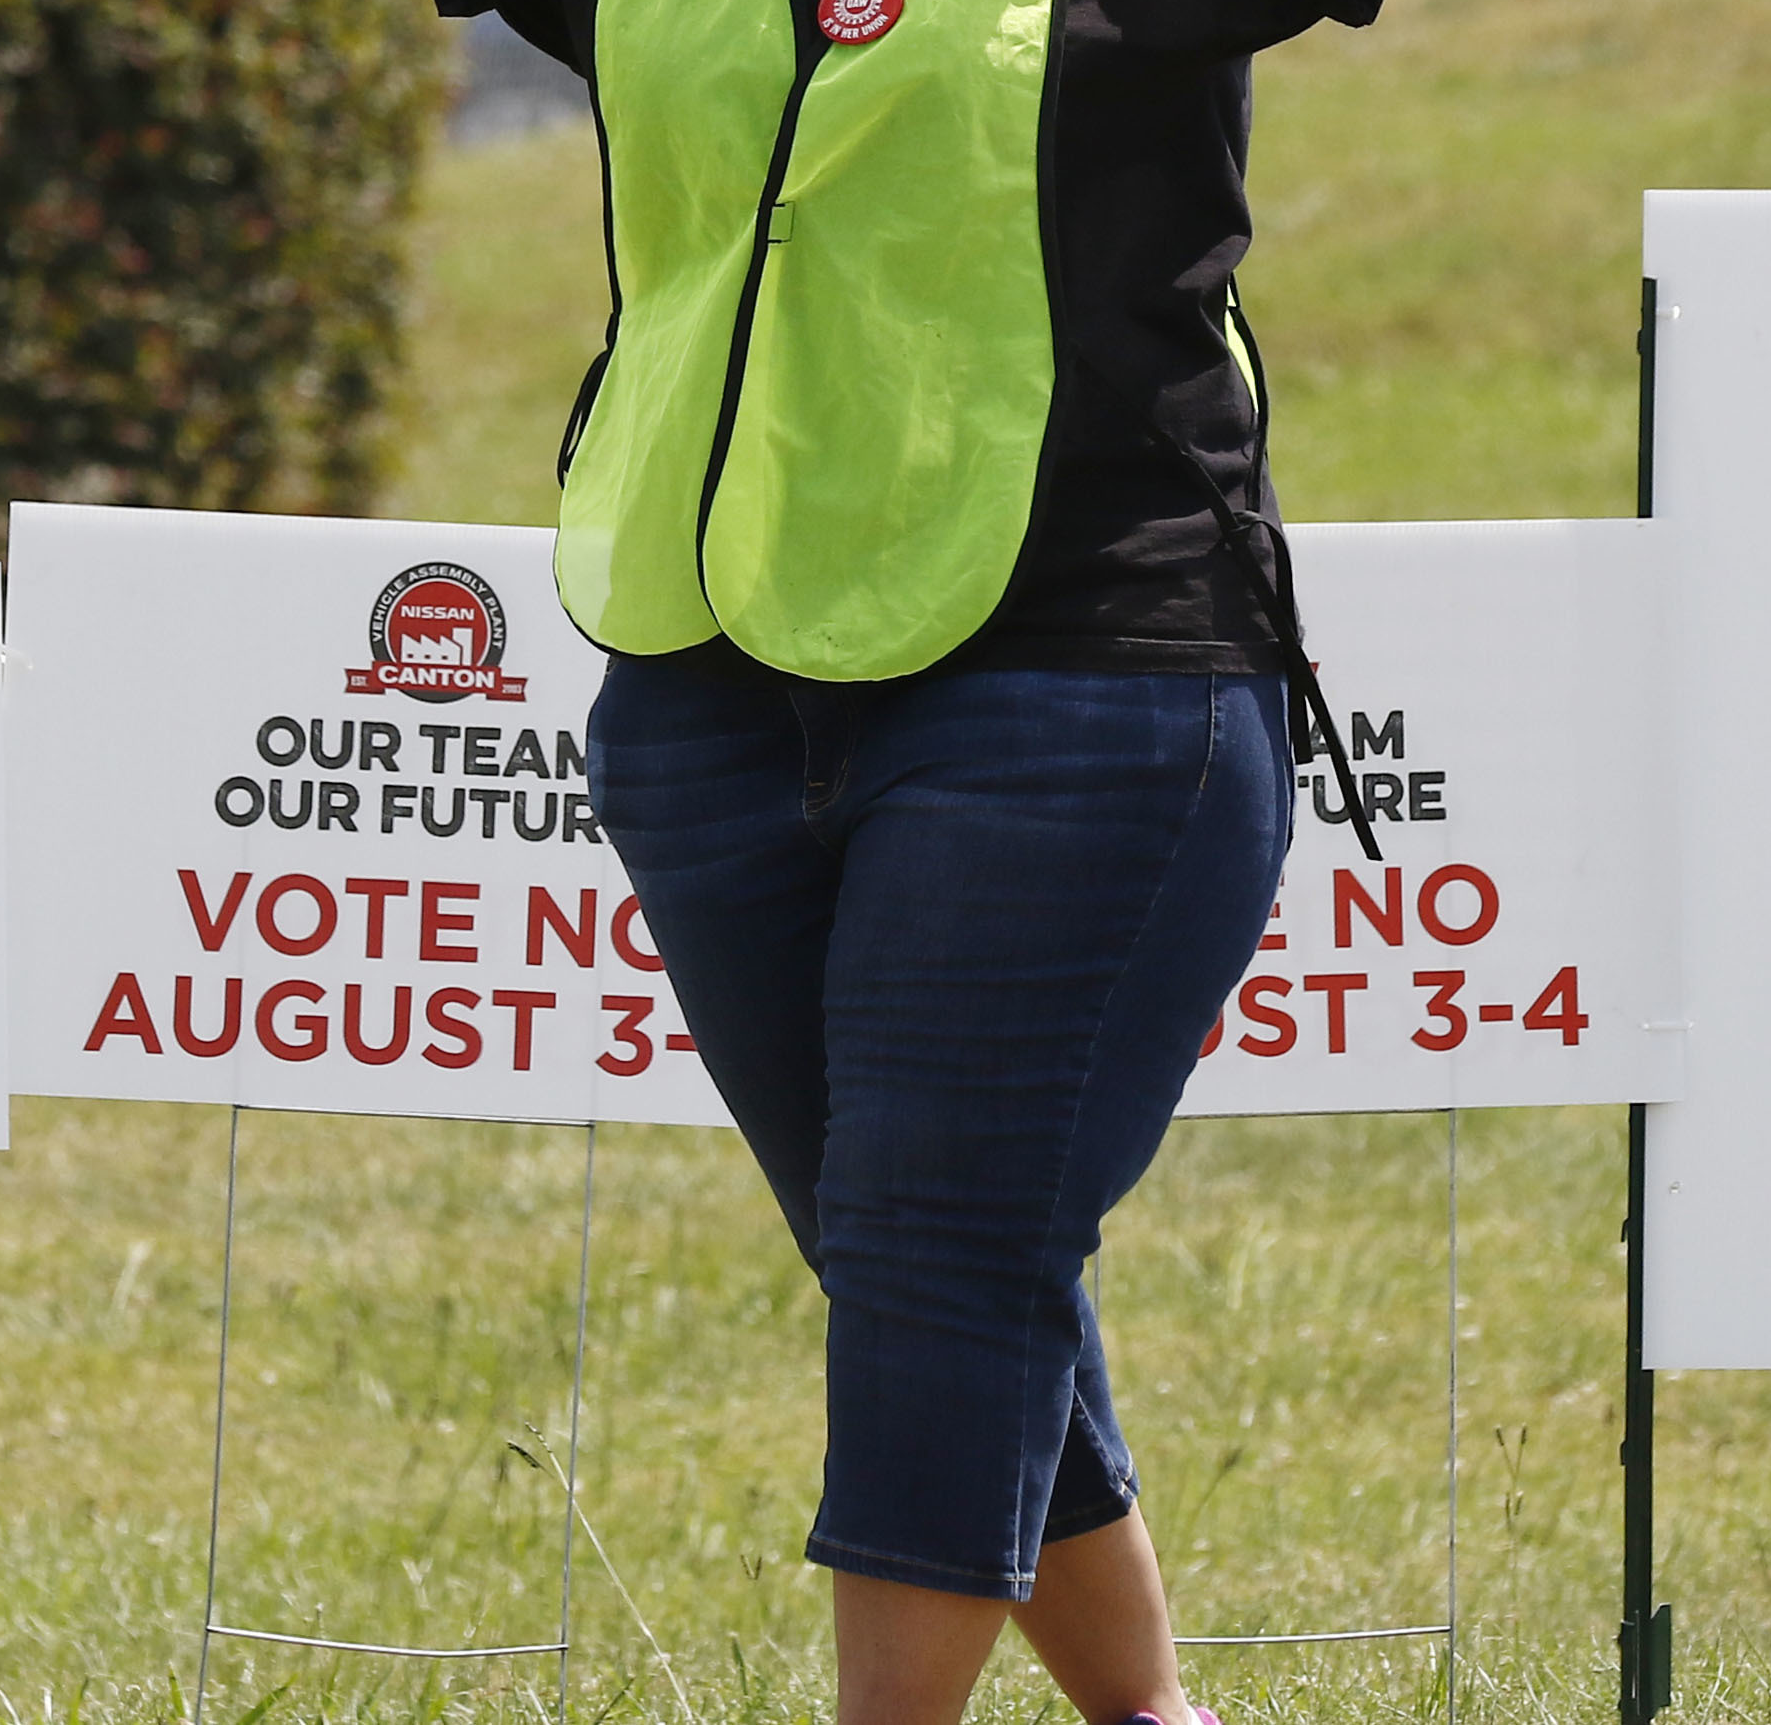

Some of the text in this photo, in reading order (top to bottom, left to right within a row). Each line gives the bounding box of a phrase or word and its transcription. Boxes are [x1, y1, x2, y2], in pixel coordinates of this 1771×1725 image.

[822, 14, 889, 38] IS IN HER UNION
[372, 566, 503, 648] VEHICLE ASSEMBLY PLANT
[401, 605, 475, 620] NISSAN
[378, 666, 494, 688] CANTON
[257, 716, 586, 779] OUR TEAM
[215, 776, 612, 844] OUR FUTUR
[177, 870, 480, 963] VOTE
[1333, 864, 1499, 947] NO
[83, 973, 698, 1077] AUGUST 3-
[1410, 966, 1589, 1052] 3-4
